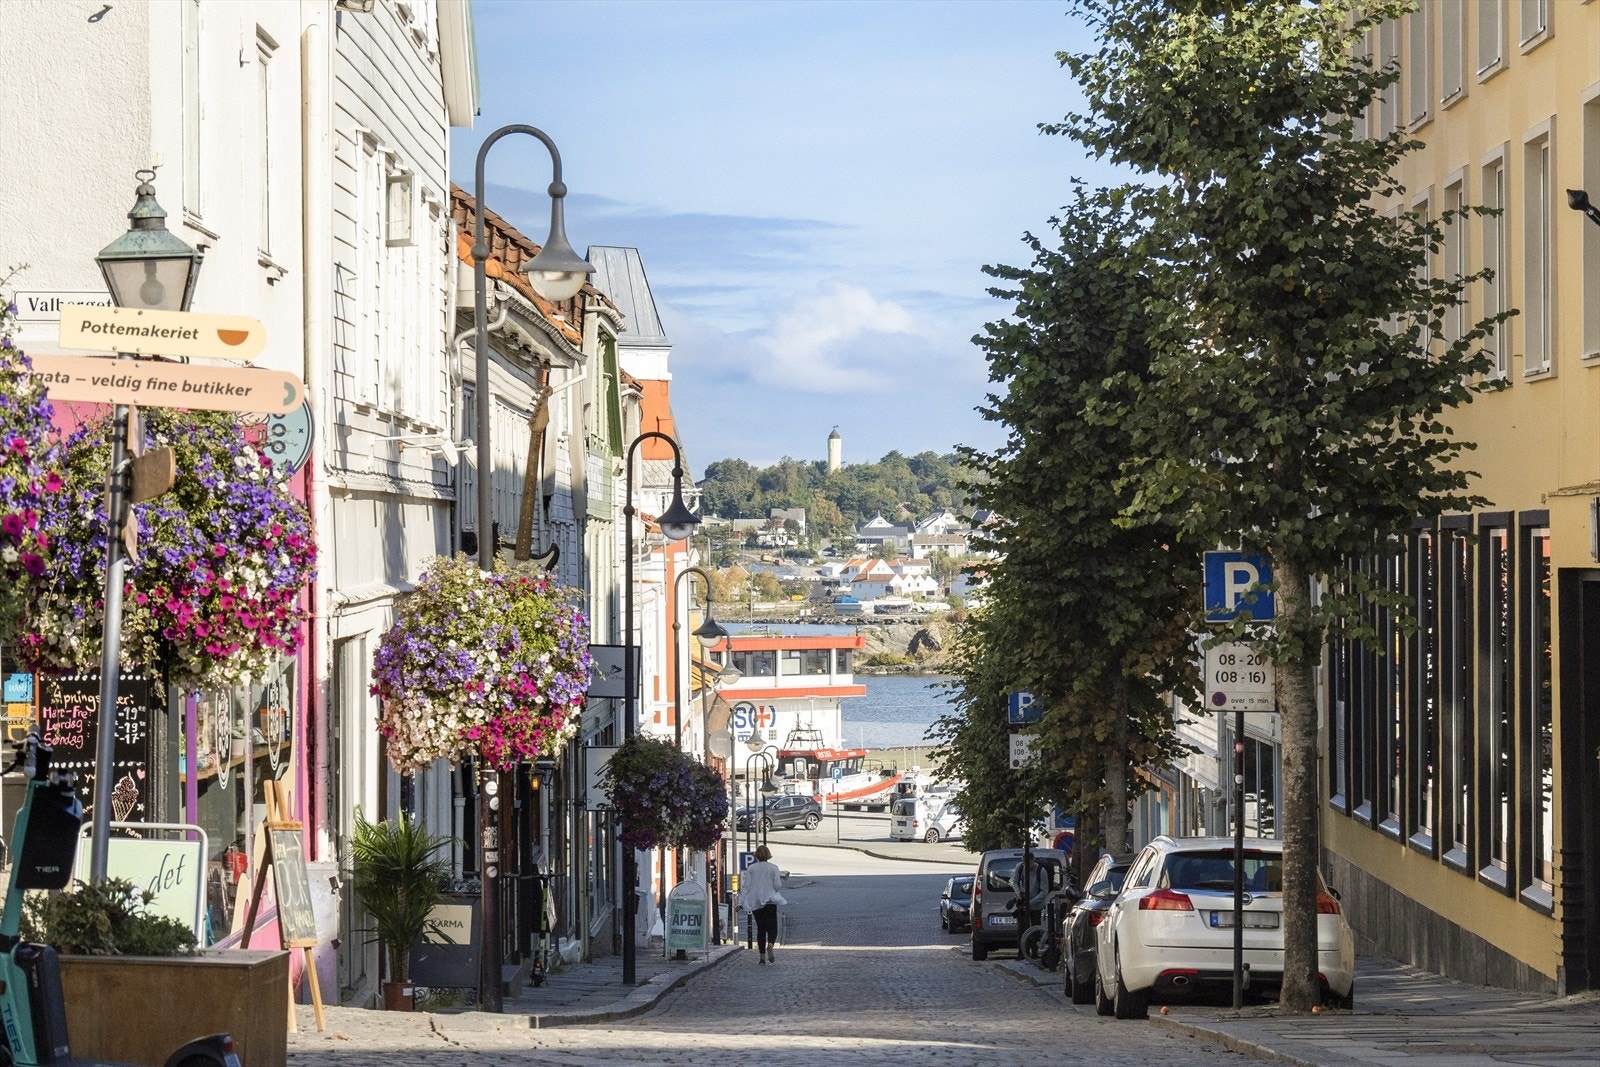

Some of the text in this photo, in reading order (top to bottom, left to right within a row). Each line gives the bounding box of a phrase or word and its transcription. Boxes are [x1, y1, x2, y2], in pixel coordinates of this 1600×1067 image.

[81, 320, 199, 340] Pottemakeriet
[91, 375, 142, 392] veldig
[146, 377, 178, 391] fine
[181, 379, 252, 397] butikker
[1224, 561, 1260, 612] P
[1219, 654, 1236, 666] 08
[1246, 653, 1263, 666] 20
[1215, 670, 1237, 684] (08
[1249, 670, 1266, 684] 16)
[1018, 692, 1036, 719] P
[1249, 696, 1255, 704] 15
[834, 768, 840, 777] P
[35, 865, 60, 873] TIER
[744, 854, 755, 869] P
[148, 853, 187, 893] det
[431, 919, 464, 928] KARMA
[672, 909, 703, 927] ÅPEN
[4, 1003, 21, 1054] TIER
